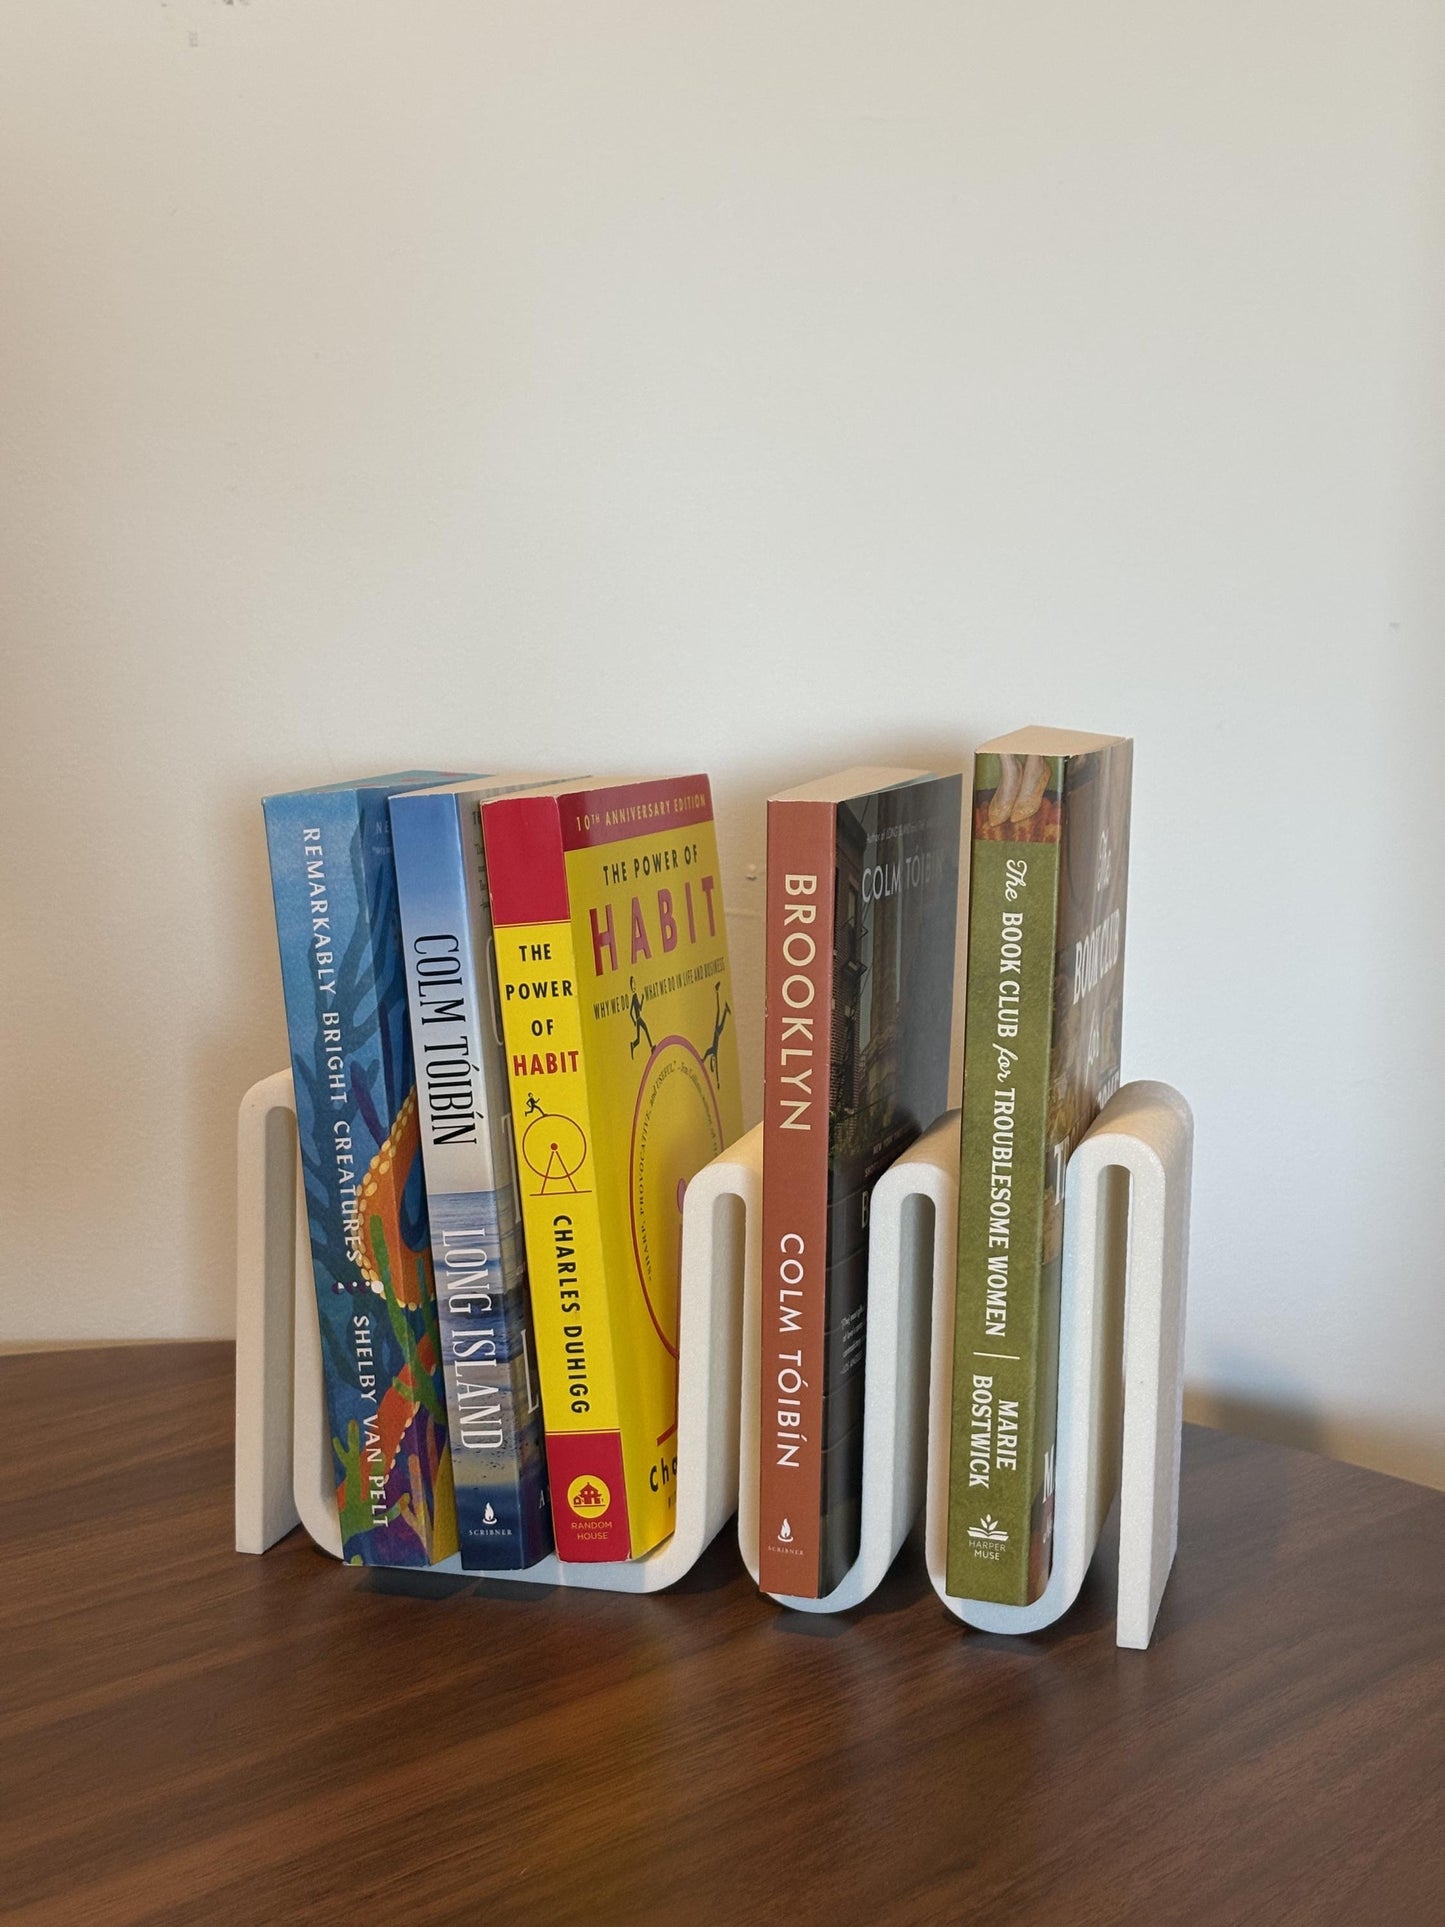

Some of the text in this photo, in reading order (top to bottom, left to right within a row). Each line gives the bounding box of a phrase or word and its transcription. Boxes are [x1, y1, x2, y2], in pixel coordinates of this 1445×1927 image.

[605, 800, 671, 826] ANNIVERSARY
[674, 794, 706, 814] EDITION
[603, 844, 698, 886] THE POWER OF
[862, 863, 901, 903] COLM
[589, 875, 717, 977] HABIT
[519, 943, 552, 962] THE
[505, 980, 573, 1001] POWER
[593, 957, 726, 1020] WHY WE DO WHAT WE DO IN LIFE AND BUSINESS
[779, 873, 818, 1131] BROOKLYN
[413, 934, 484, 1146] COLM TÓIBÍN
[531, 1018, 554, 1037] OF
[513, 1050, 579, 1076] HABIT
[985, 859, 1027, 1337] The BOOK CLUB for TROUBLESOME WOMEN
[302, 828, 390, 1527] REMARKABLY BRIGHT CREATURES SHELBY VAN PELT
[553, 1214, 590, 1414] CHARLES DUHIGG
[442, 1228, 504, 1450] LONG ISLAND
[776, 1232, 809, 1468] COLM TÓIBÍN
[968, 1374, 993, 1489] BOSTWICK
[997, 1399, 1019, 1471] MARIE
[650, 1456, 678, 1492] Cha
[468, 1527, 513, 1537] SCRIBNER
[571, 1522, 612, 1530] RANDOM
[577, 1531, 608, 1540] HOUSE
[968, 1540, 1006, 1552] HARPER
[767, 1545, 805, 1557] SCRIBNER
[974, 1551, 1000, 1560] MUSE
